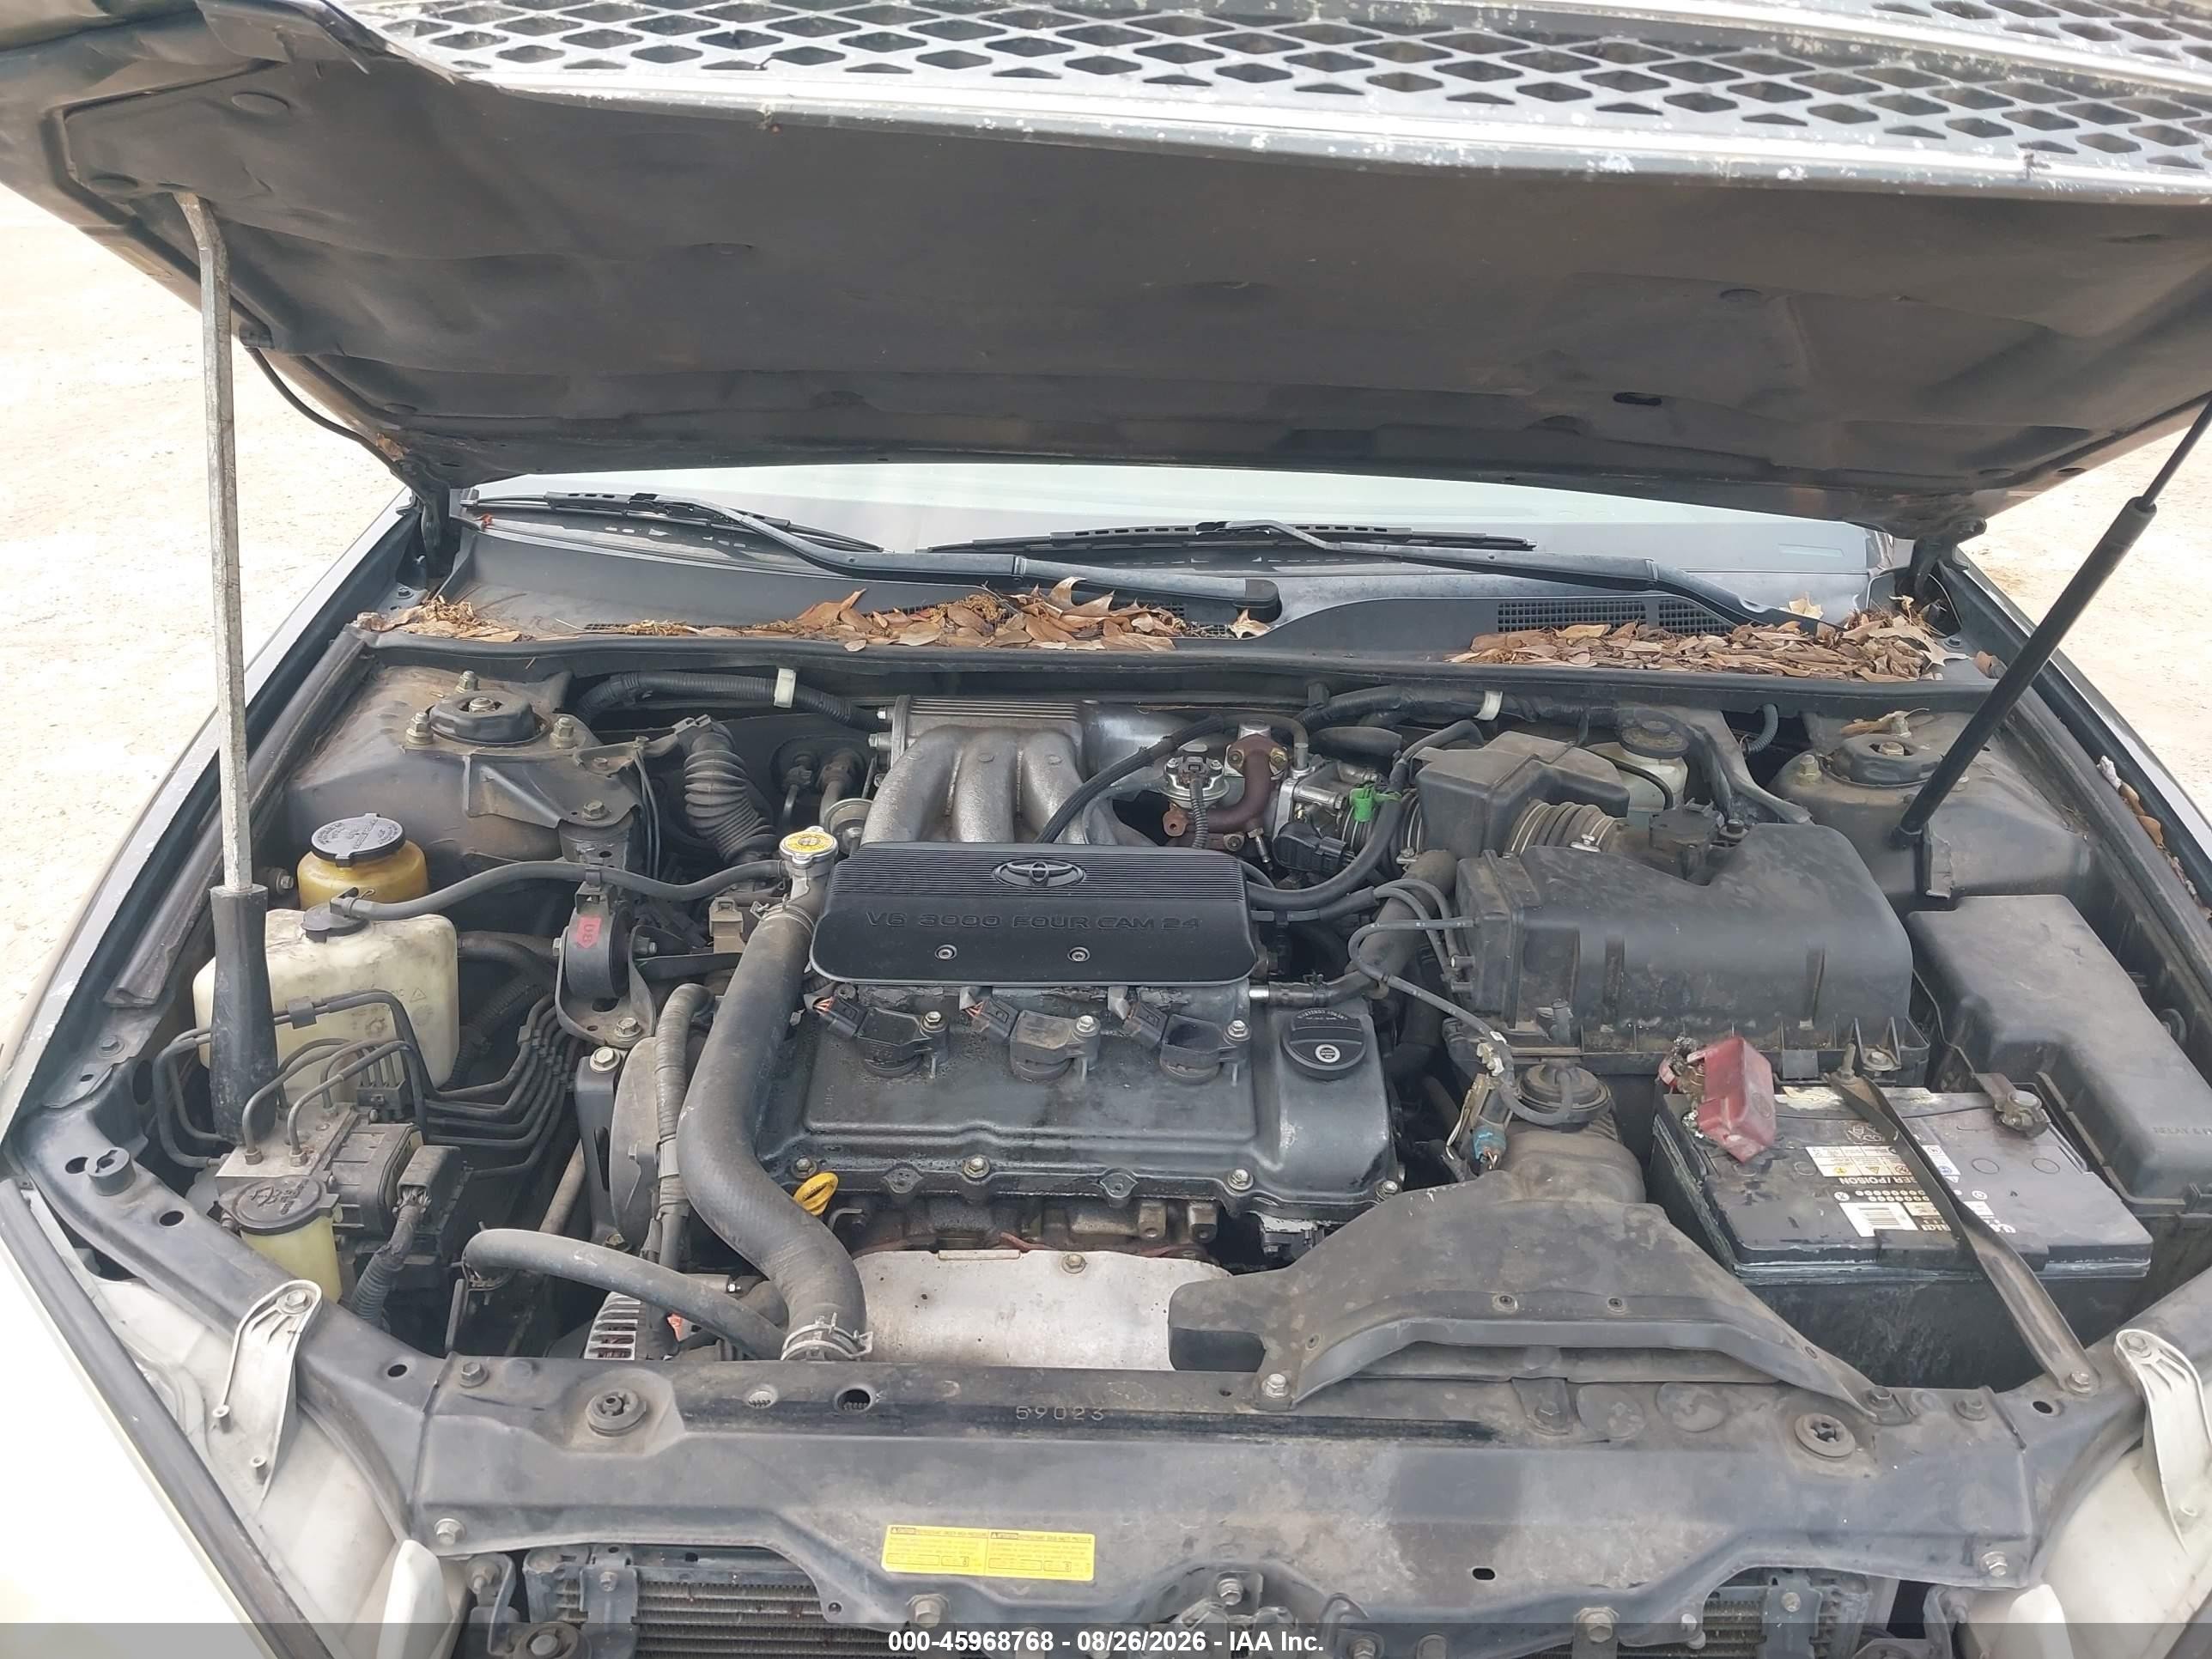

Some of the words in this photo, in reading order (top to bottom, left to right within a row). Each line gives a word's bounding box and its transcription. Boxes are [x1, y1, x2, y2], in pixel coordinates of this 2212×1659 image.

[865, 910, 908, 927] V6
[919, 913, 1001, 928] 3000
[1012, 914, 1091, 930] FOUR
[1097, 915, 1155, 930] CAM
[1160, 915, 1200, 931] 24
[1016, 1406, 1104, 1421] 59023
